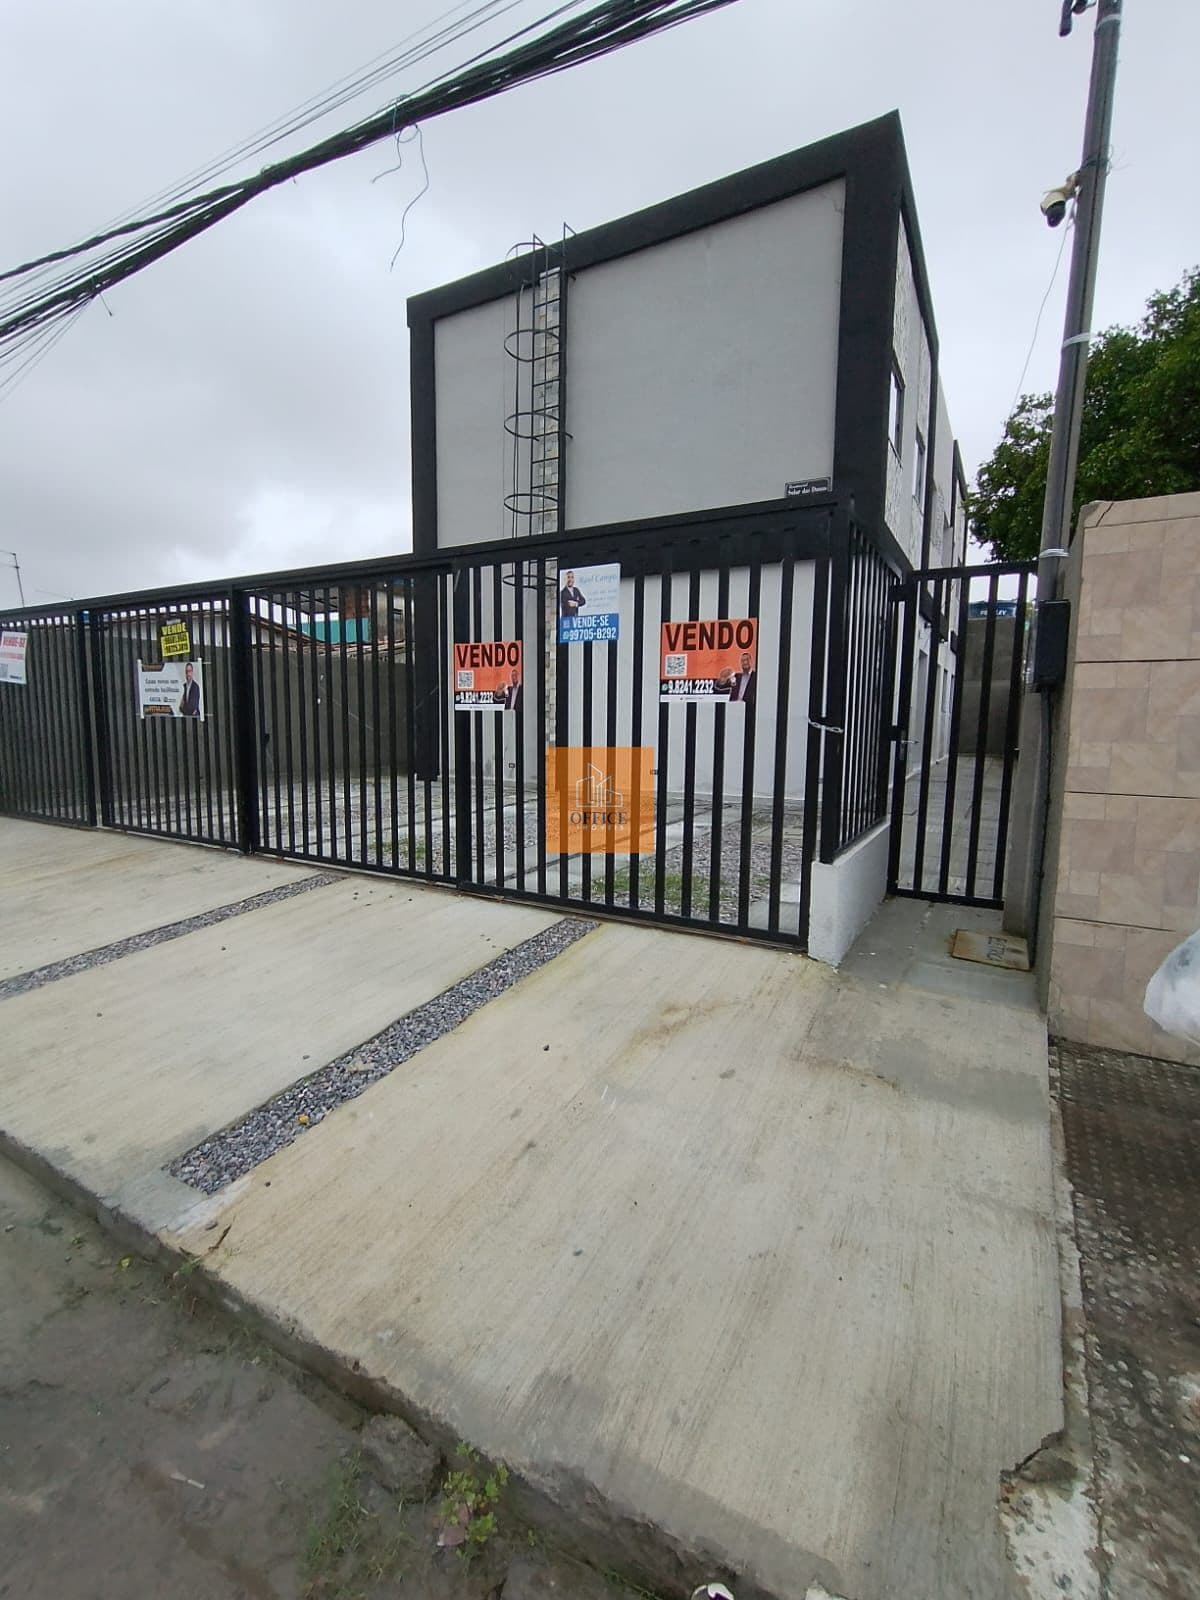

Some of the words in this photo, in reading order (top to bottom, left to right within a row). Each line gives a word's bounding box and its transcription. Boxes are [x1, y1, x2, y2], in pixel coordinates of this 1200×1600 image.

[573, 615, 610, 629] VENDE-SE
[664, 620, 754, 651] VENDO
[456, 642, 520, 668] VENDO
